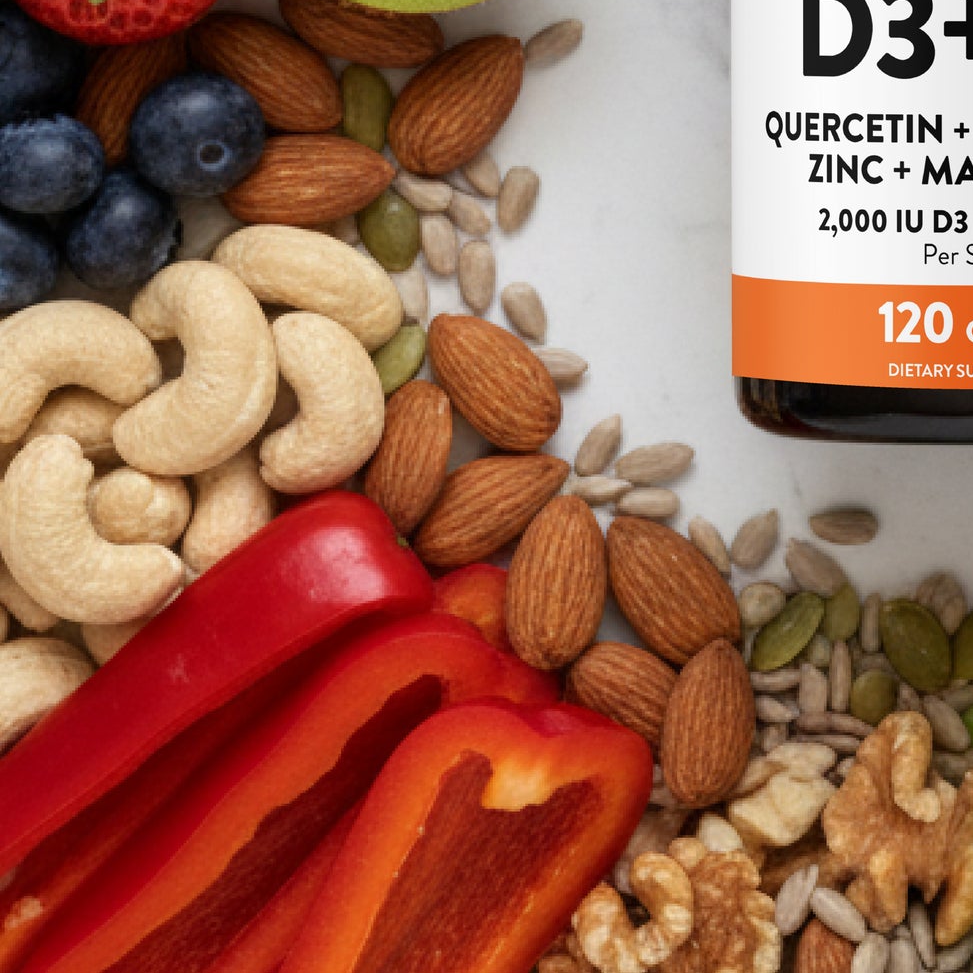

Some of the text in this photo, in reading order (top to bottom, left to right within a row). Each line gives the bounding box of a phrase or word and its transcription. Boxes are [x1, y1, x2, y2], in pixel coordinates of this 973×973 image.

[765, 110, 943, 148] QUERCETIN
[953, 122, 970, 139] +
[808, 153, 884, 185] ZINC
[893, 160, 911, 180] +
[818, 207, 887, 238] 2,000
[896, 209, 924, 234] IU
[933, 209, 969, 234] D3
[924, 243, 960, 265] Per
[878, 300, 954, 344] 120
[888, 362, 954, 378] DIETARY
